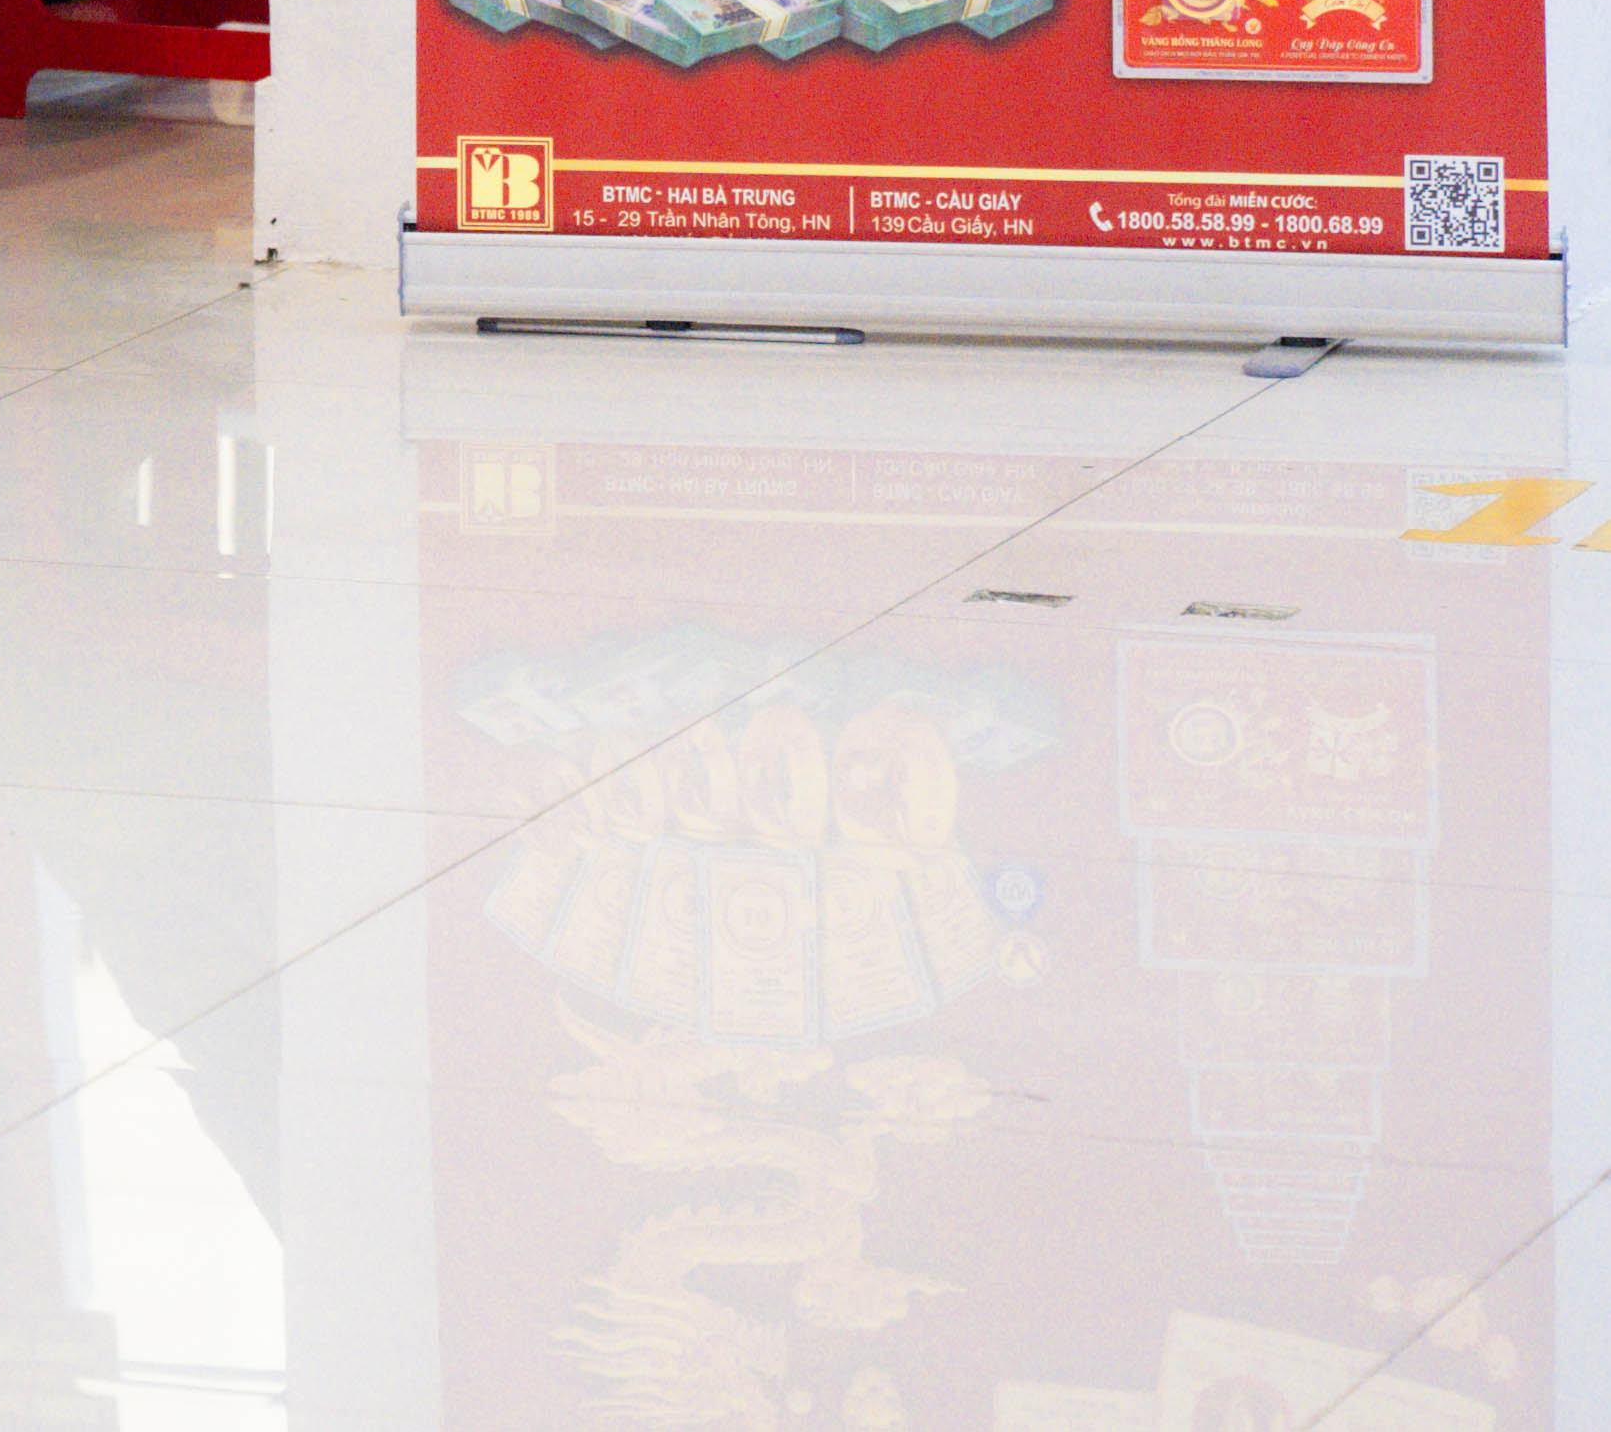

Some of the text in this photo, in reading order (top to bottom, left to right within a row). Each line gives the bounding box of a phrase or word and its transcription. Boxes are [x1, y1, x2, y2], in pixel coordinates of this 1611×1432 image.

[603, 184, 795, 207] BTMC HAI BÀ TRƯNG
[871, 191, 921, 209] BTMC
[936, 184, 973, 211] CẦU
[1168, 192, 1200, 212] Tổng
[1205, 194, 1225, 209] đài
[573, 208, 830, 234] 15 29 Trần Nhân Tông, HN
[872, 216, 904, 234] 139
[908, 214, 945, 234] Cầu
[1004, 218, 1033, 236] HN
[1118, 211, 1383, 235] 1800.58.58.99 1800.68.99
